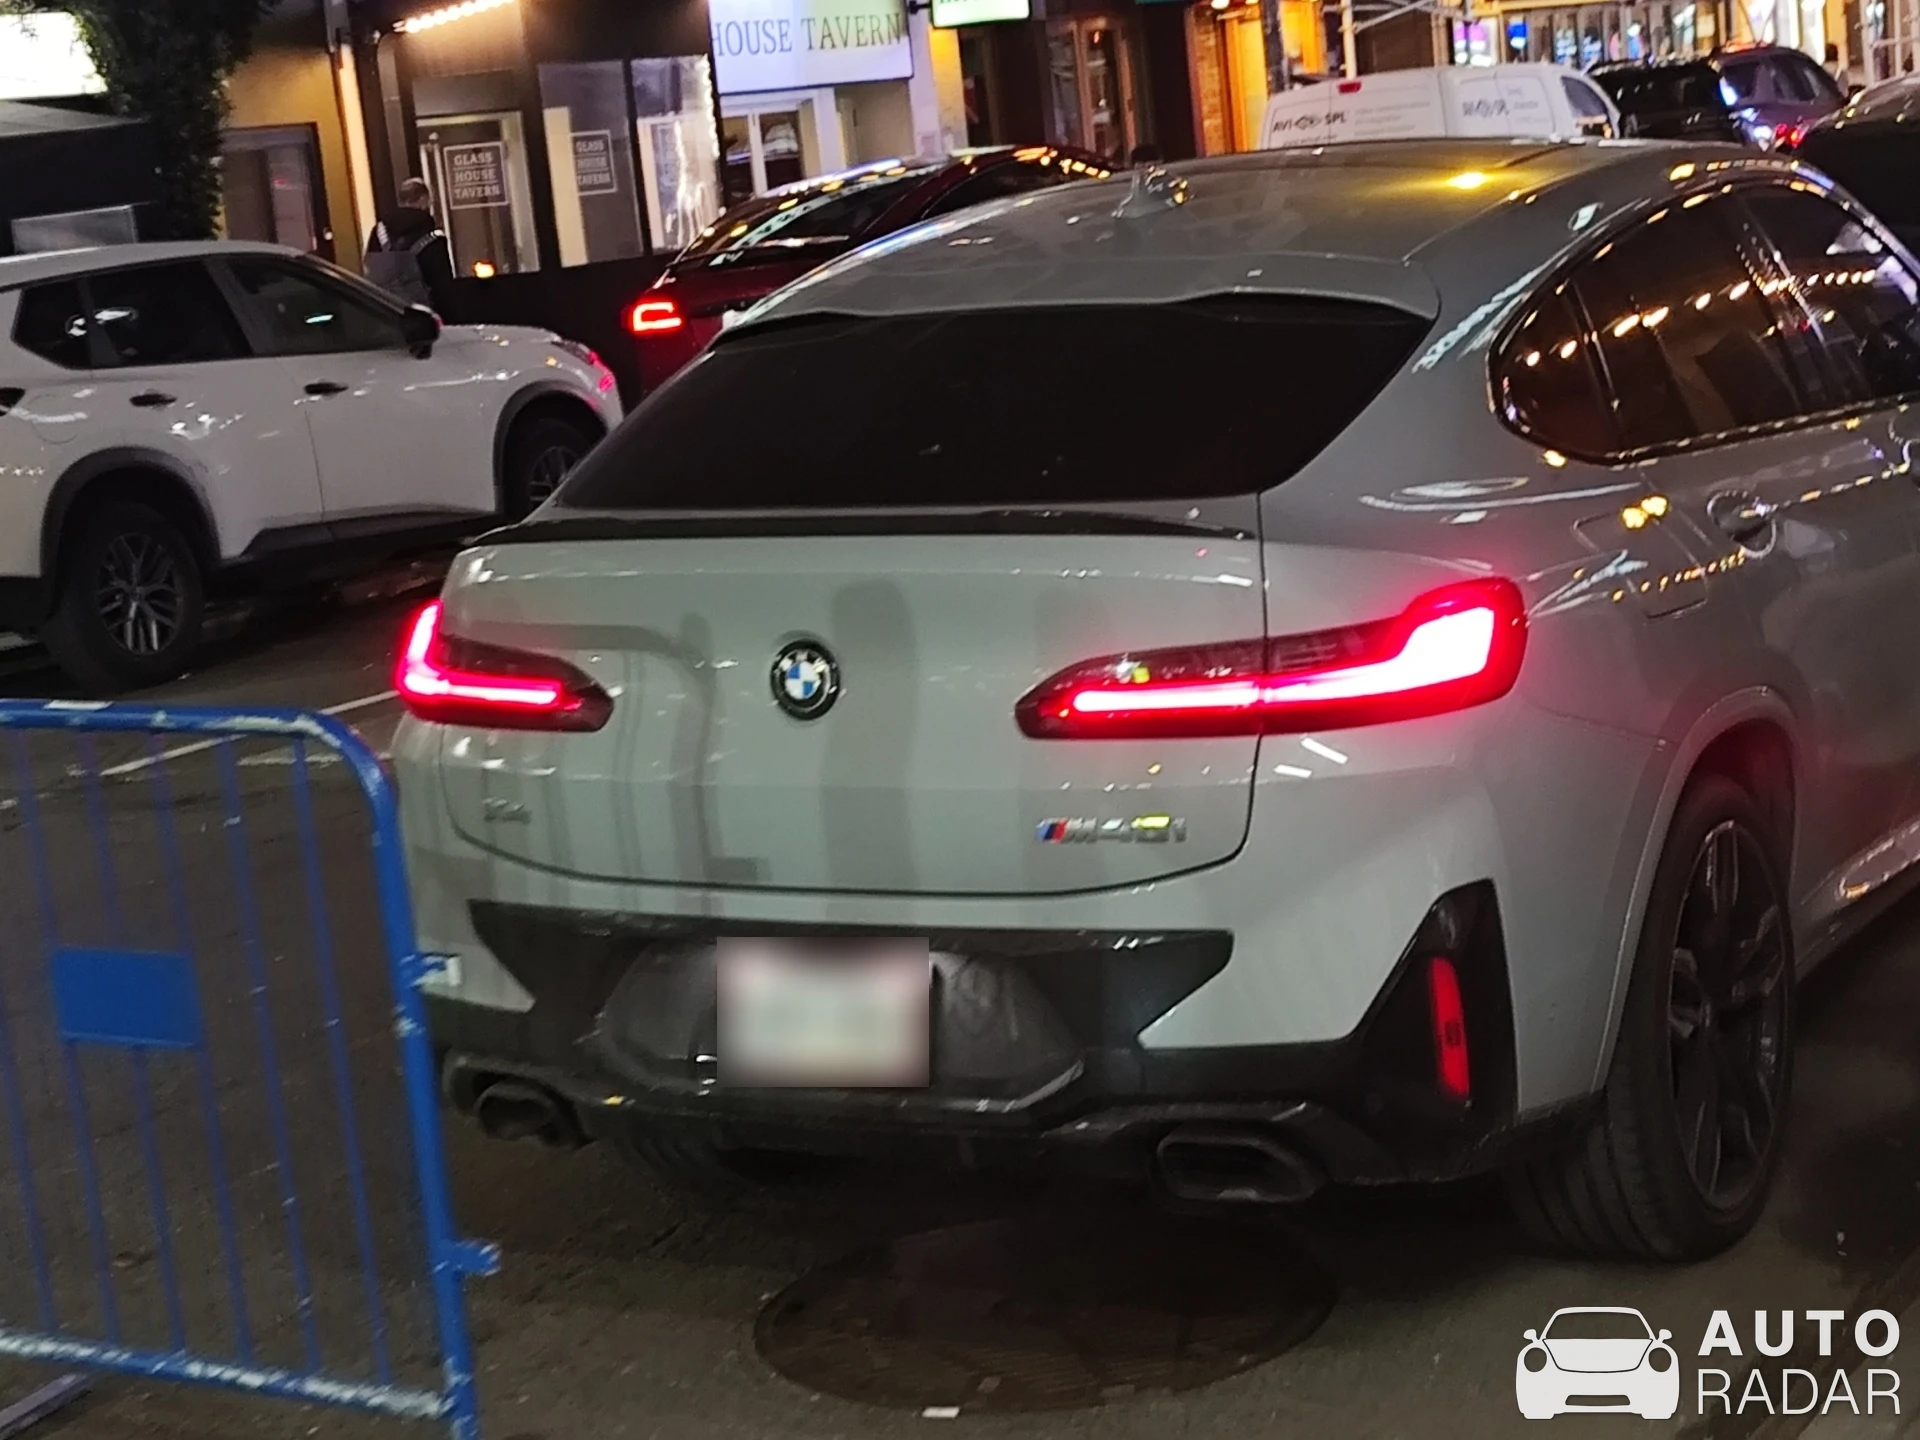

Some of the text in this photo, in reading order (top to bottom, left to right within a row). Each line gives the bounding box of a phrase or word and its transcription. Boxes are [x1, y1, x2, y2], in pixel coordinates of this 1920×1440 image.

[800, 12, 901, 51] TAVERN
[454, 153, 492, 165] GLASS
[454, 169, 494, 182] HOUSE
[454, 186, 500, 199] TAVERN
